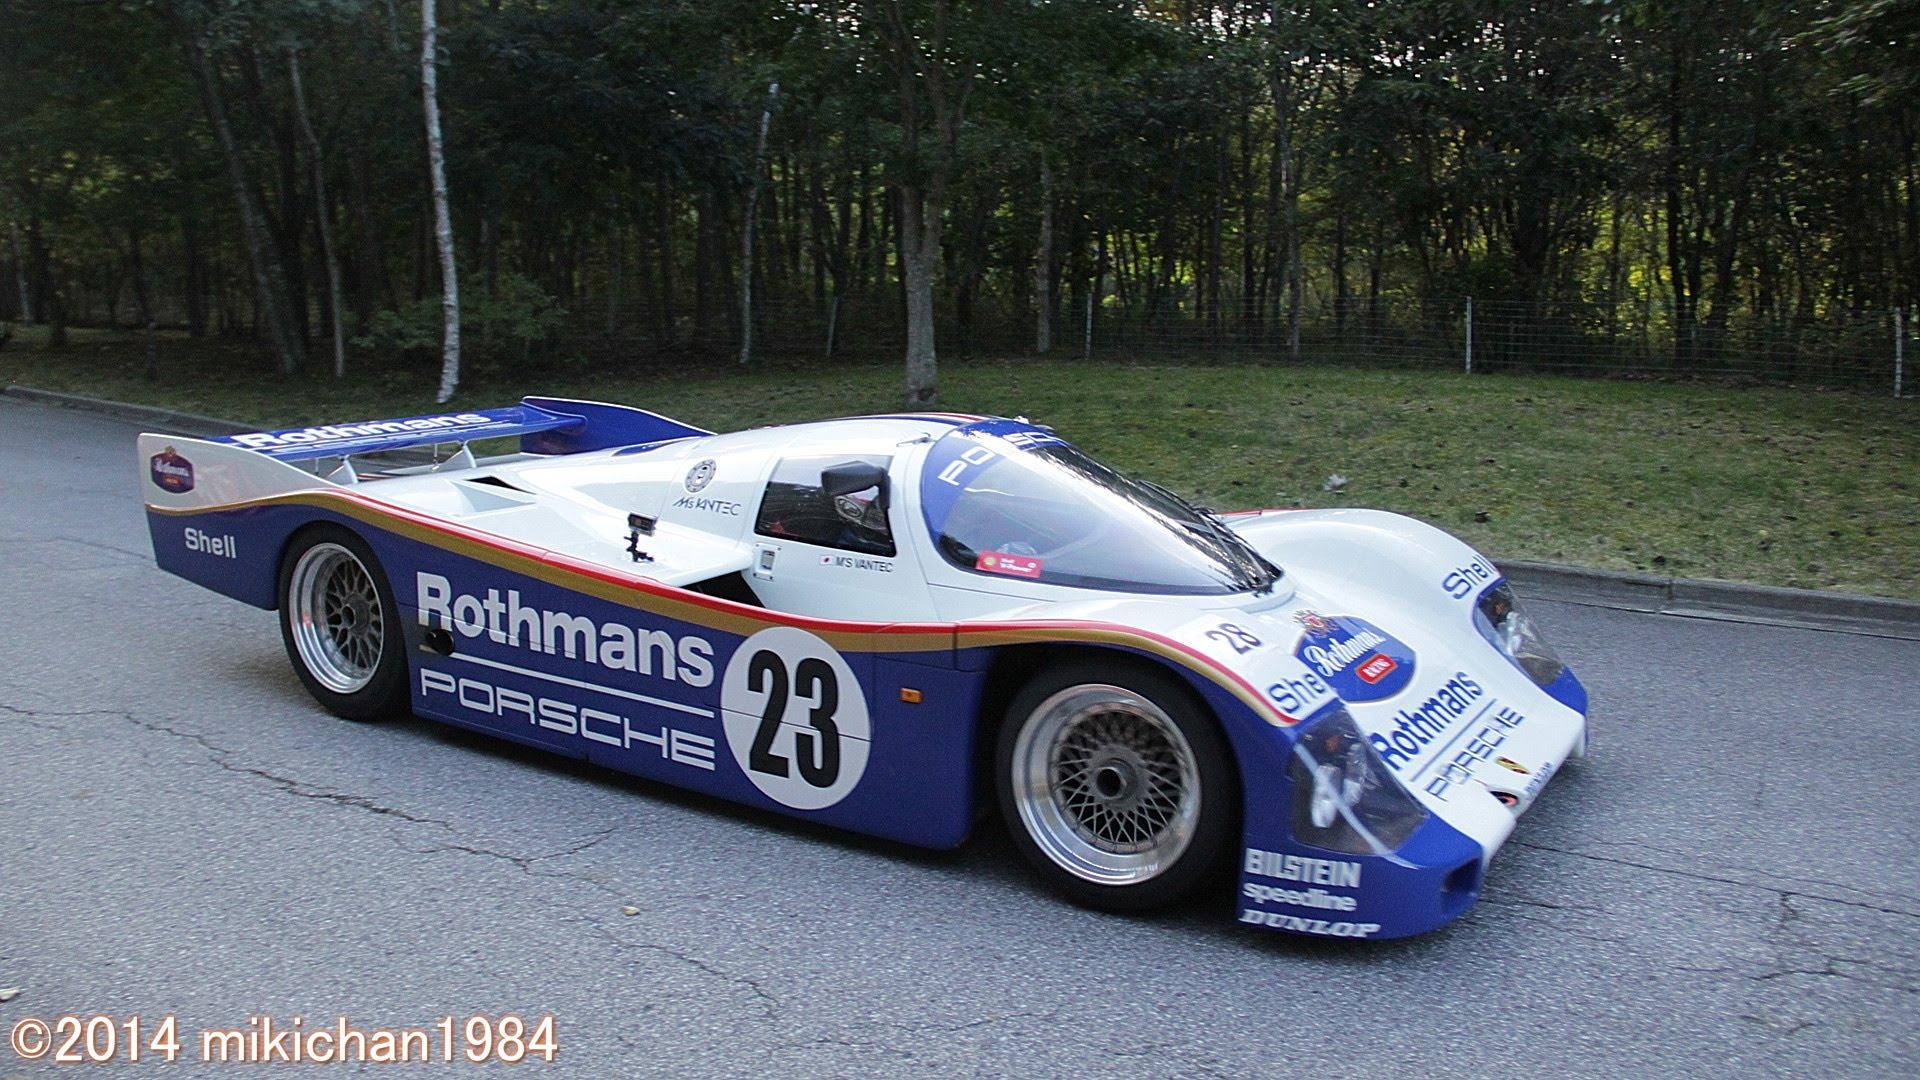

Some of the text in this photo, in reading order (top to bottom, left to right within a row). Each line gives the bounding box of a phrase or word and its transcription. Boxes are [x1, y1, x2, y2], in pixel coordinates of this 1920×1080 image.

[231, 413, 491, 447] Rothmans
[184, 526, 237, 559] Shell
[854, 558, 893, 573] VANTEC
[1442, 554, 1497, 600] Shell
[416, 571, 714, 688] Rothmans
[1205, 623, 1262, 655] 28
[420, 667, 716, 772] PORSCHE
[747, 649, 840, 789] 23
[1369, 671, 1483, 771] Rothmans
[1424, 706, 1526, 802] PORSCHE
[1244, 847, 1361, 888] BILSTEIN
[1242, 882, 1358, 911] speedline
[1239, 908, 1381, 938] DUNLOP
